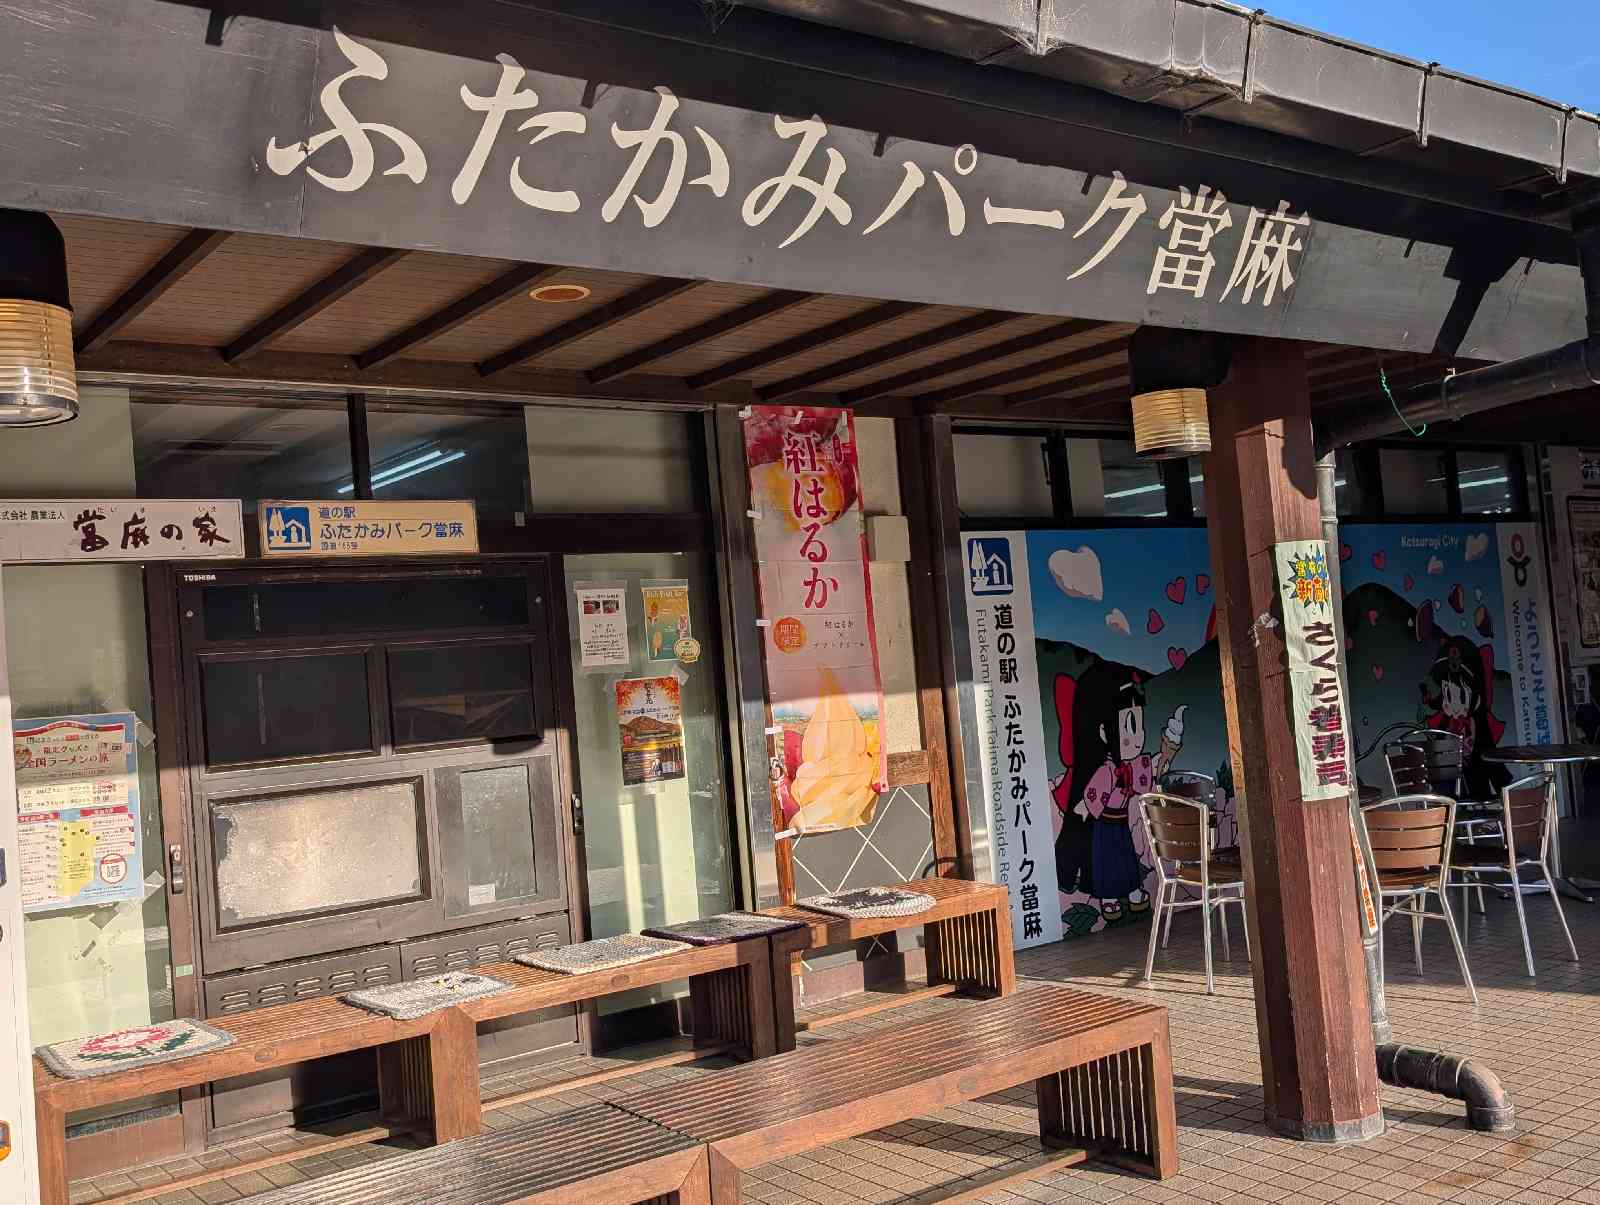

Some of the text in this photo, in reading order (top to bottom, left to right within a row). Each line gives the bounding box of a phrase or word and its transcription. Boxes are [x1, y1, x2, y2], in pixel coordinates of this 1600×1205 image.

[266, 24, 1312, 306] ふたかみパーク當麻
[318, 506, 357, 519] 道の駅
[320, 521, 465, 540] ふたかみパーク當麻
[783, 432, 839, 609] 紅はるか
[975, 608, 993, 688] Futakami
[983, 689, 998, 727] Park
[993, 603, 1043, 940] 道の駅 ふたかみパーク當麻
